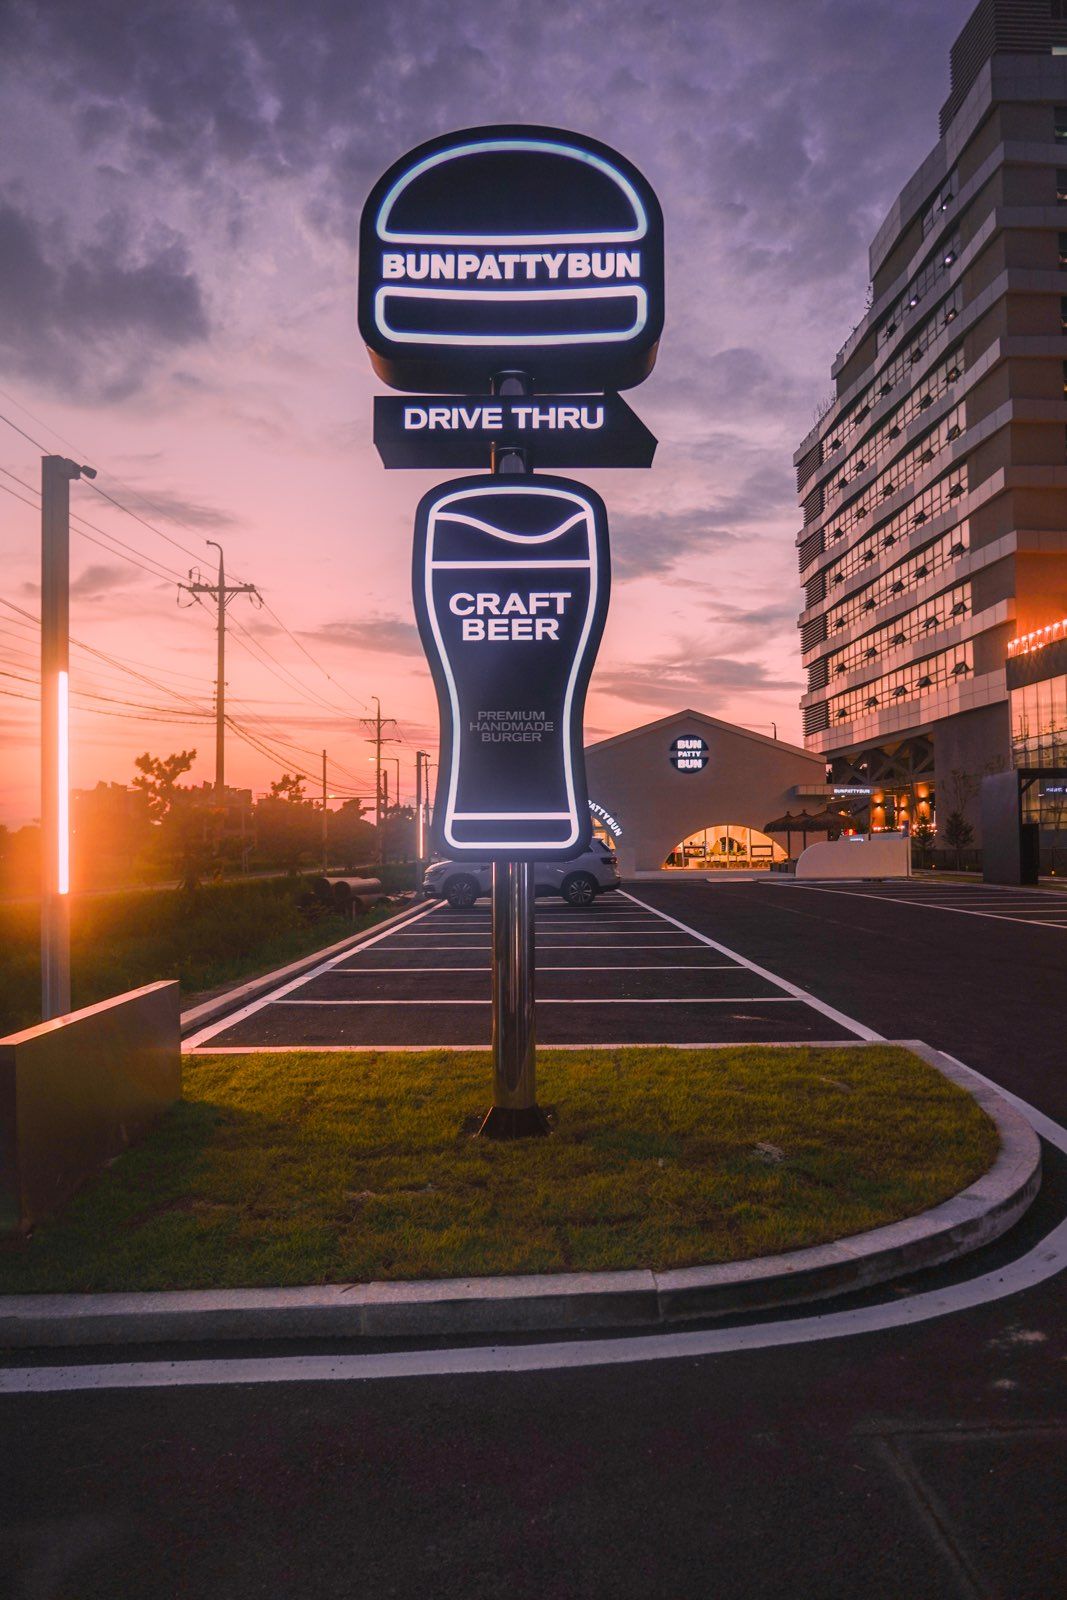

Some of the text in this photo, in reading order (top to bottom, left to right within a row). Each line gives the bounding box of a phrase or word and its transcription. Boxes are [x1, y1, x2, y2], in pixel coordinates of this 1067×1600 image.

[383, 253, 641, 279] BUNPATTYBUN
[405, 407, 604, 430] DRIVE THRU
[449, 592, 572, 615] CRAFT
[462, 618, 560, 642] BEER
[478, 711, 545, 721] PREMIUM
[469, 722, 554, 732] HANDMADE
[481, 732, 542, 742] BURGER
[677, 739, 702, 749] BUN
[677, 750, 701, 758] PATTY
[677, 759, 702, 769] BUN
